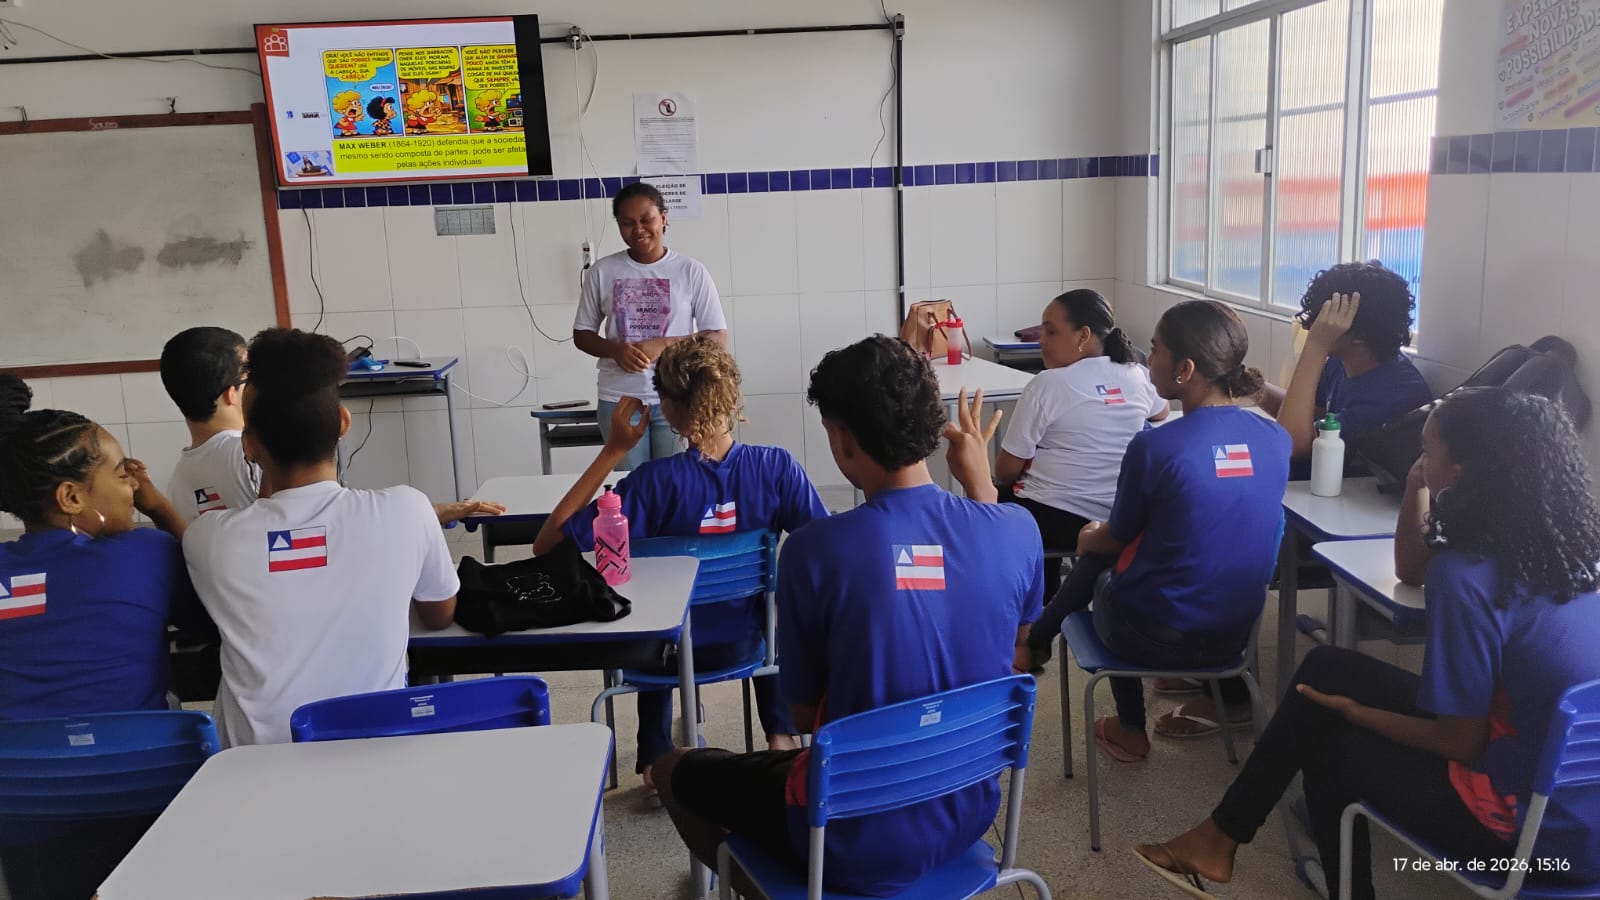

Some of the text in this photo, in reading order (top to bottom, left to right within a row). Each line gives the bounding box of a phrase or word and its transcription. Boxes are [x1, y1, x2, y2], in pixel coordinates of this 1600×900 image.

[1528, 0, 1579, 44] NOVAS
[358, 141, 387, 149] WEBER
[436, 137, 469, 146] defendia
[370, 151, 393, 159] sendo
[395, 149, 432, 158] composta
[396, 160, 417, 169] pelas
[443, 157, 482, 167] individuais
